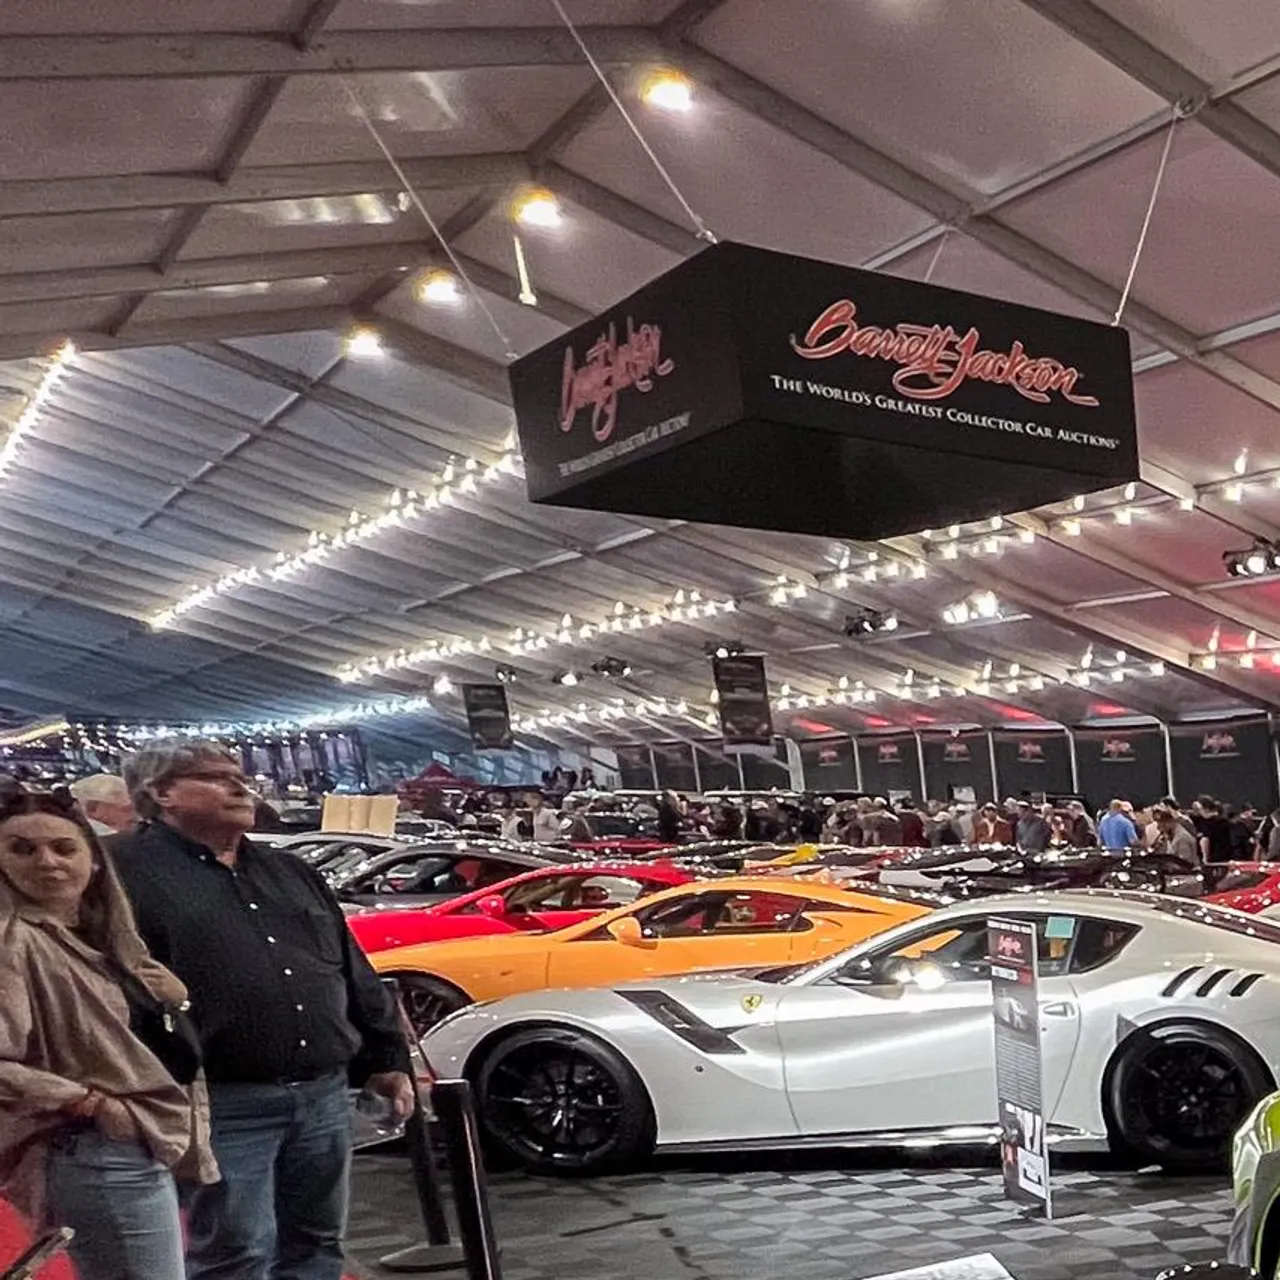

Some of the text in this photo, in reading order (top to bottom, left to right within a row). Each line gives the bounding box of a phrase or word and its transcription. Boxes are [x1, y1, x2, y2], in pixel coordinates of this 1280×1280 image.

[770, 375, 803, 393] THE
[807, 381, 871, 406] WORLD'S
[875, 394, 943, 419] GREATEST
[947, 408, 1024, 435] COLLECTOR
[1025, 422, 1053, 439] CAR
